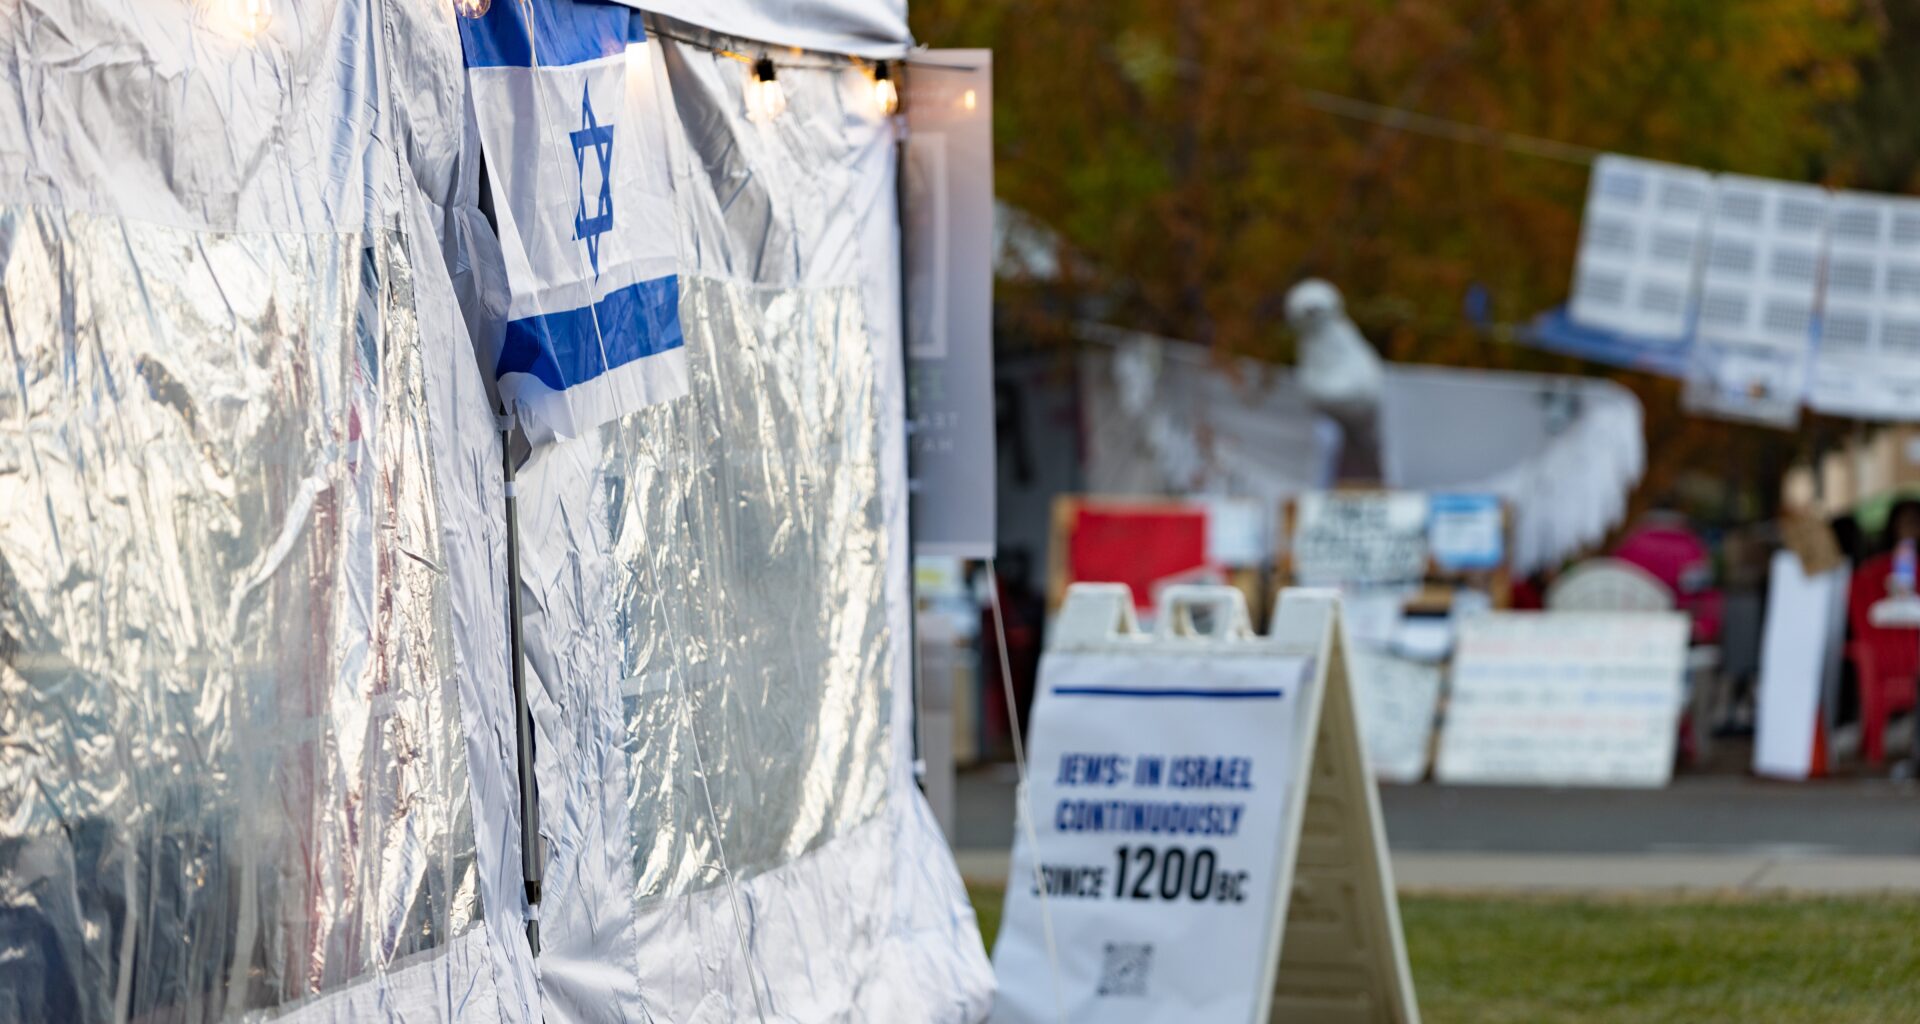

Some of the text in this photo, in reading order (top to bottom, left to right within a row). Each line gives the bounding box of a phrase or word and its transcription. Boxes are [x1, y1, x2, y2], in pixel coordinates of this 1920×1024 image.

[1134, 754, 1163, 786] IN
[1167, 755, 1253, 790] ISRAEL
[1055, 799, 1244, 834] CONTINUOUSLY
[1032, 845, 1249, 902] SINCE 1200 BC
